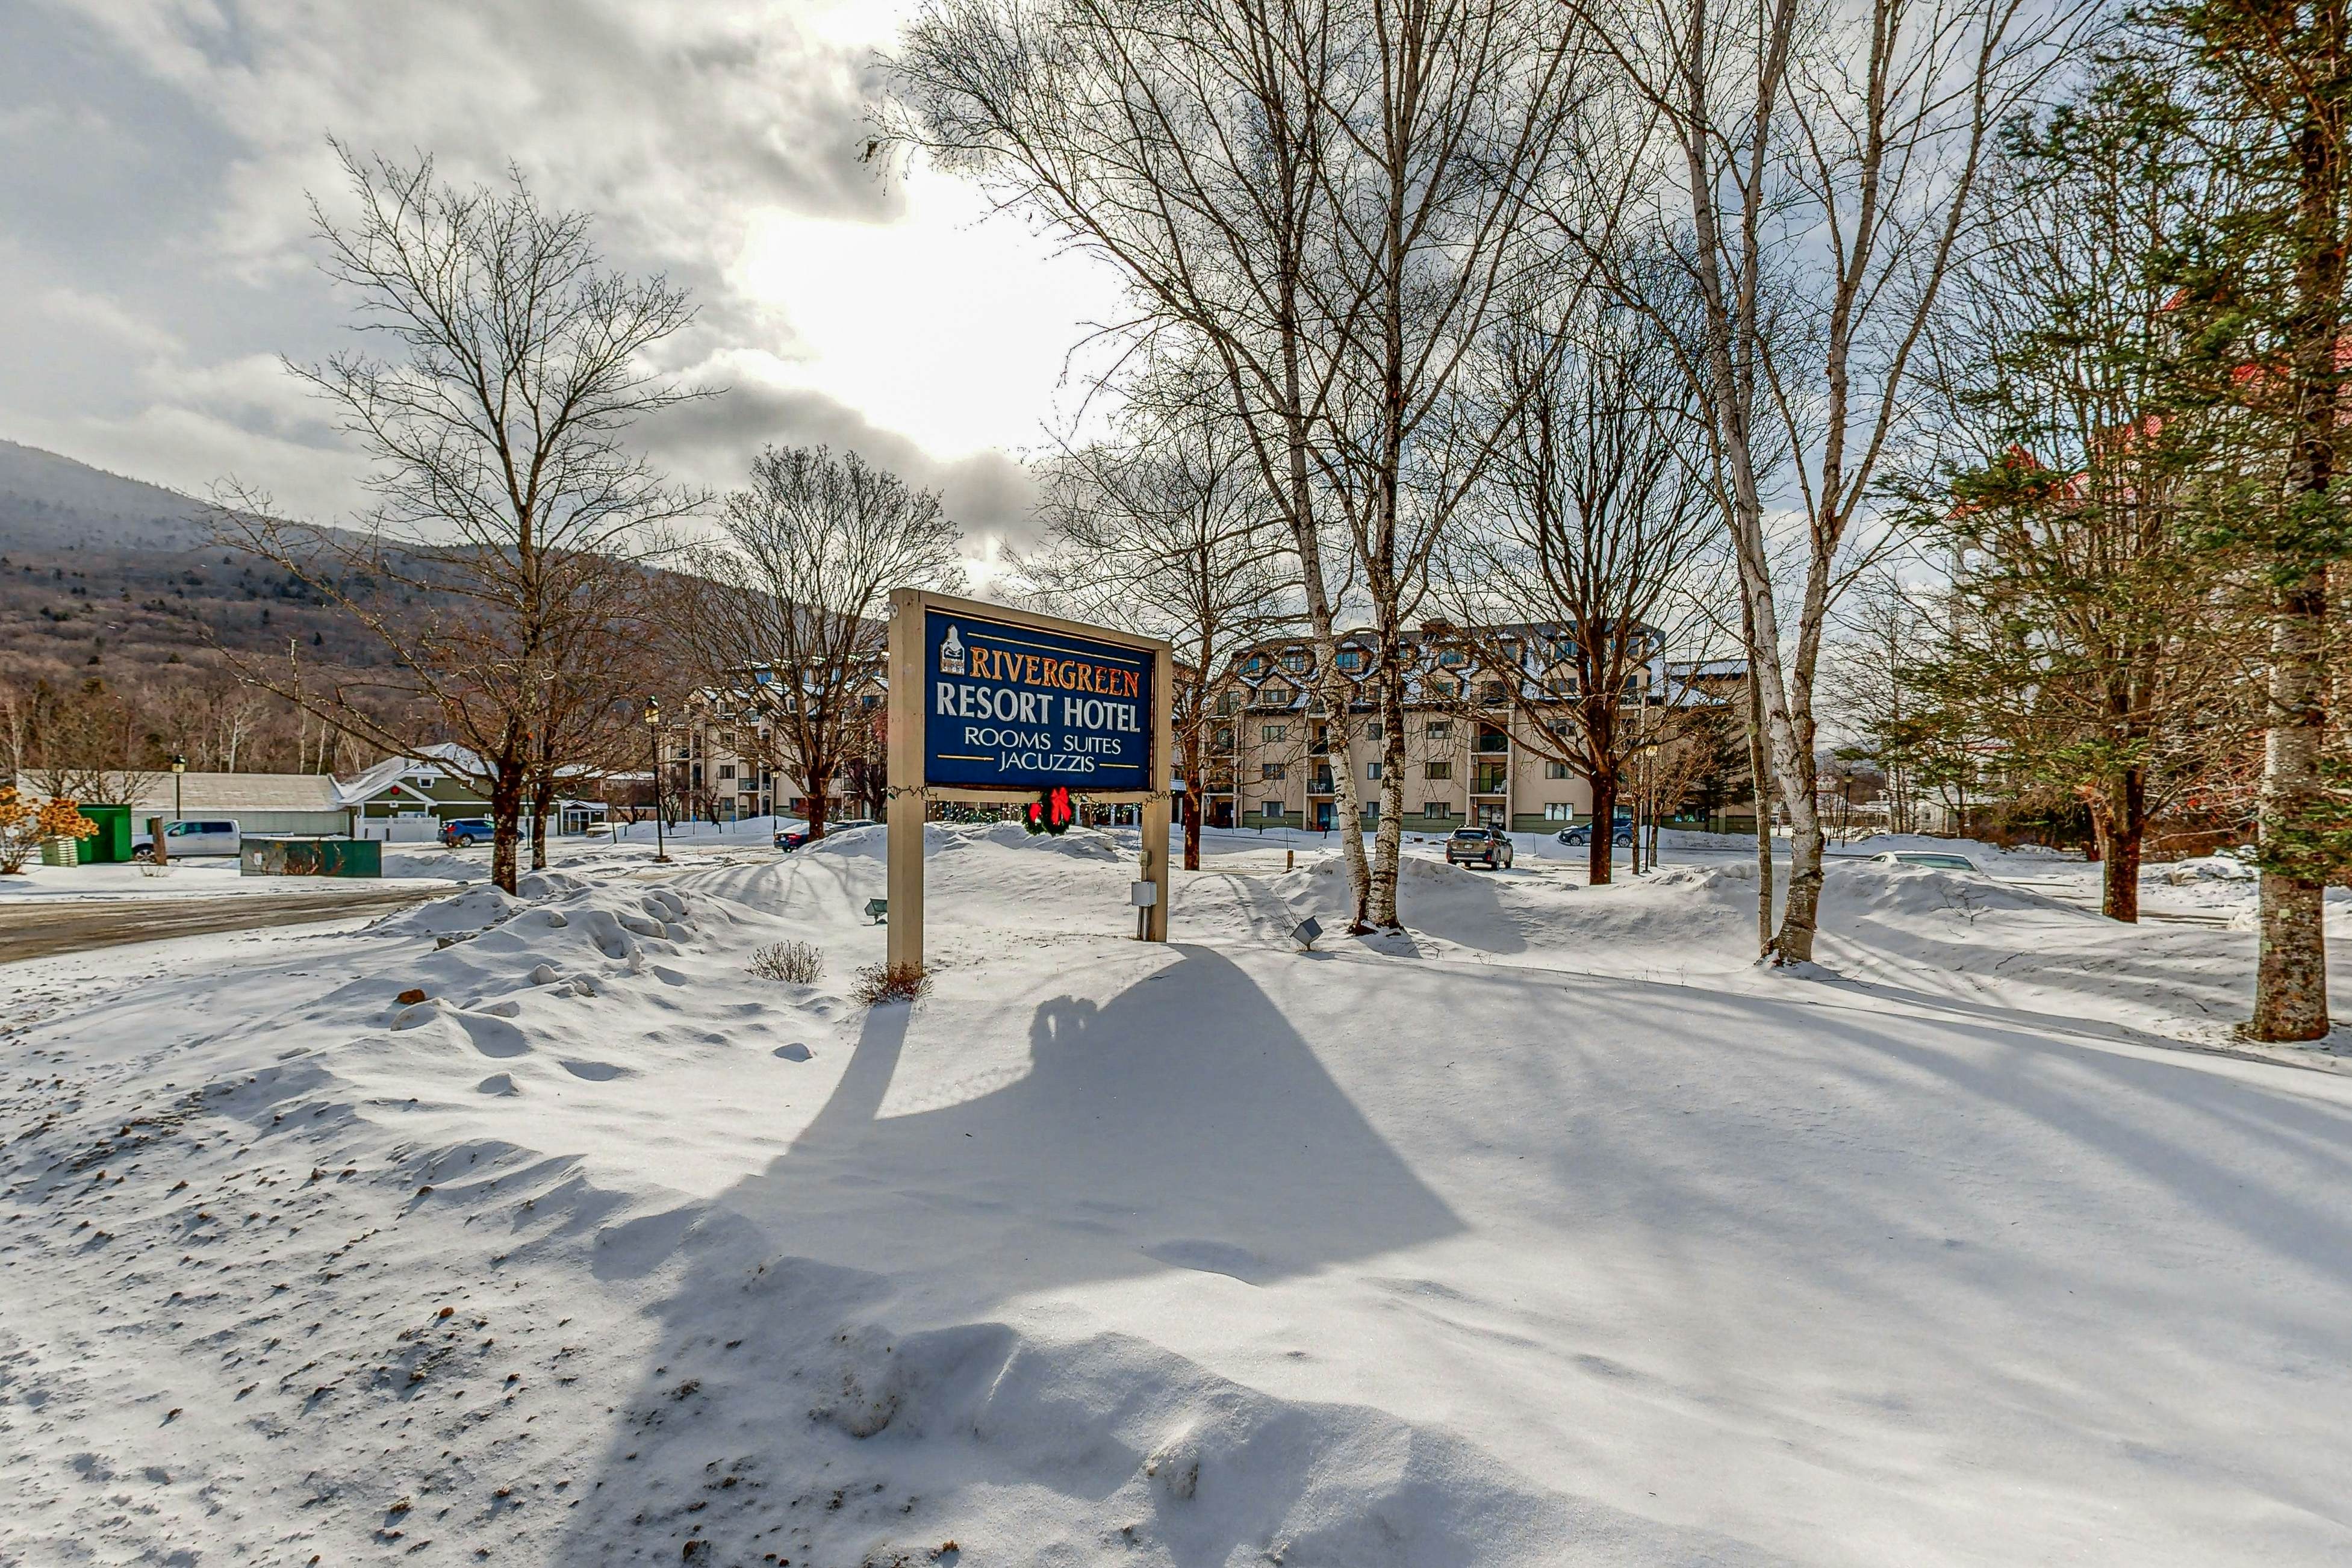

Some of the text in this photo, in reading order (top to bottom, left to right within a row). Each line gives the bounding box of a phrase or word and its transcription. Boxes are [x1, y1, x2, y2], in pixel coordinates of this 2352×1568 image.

[971, 647, 1140, 698] RIVERGREEN
[936, 682, 1140, 733] RESORT HOTEL
[965, 727, 1121, 754] ROOMS SUITES
[998, 751, 1095, 773] JACUZZIS
